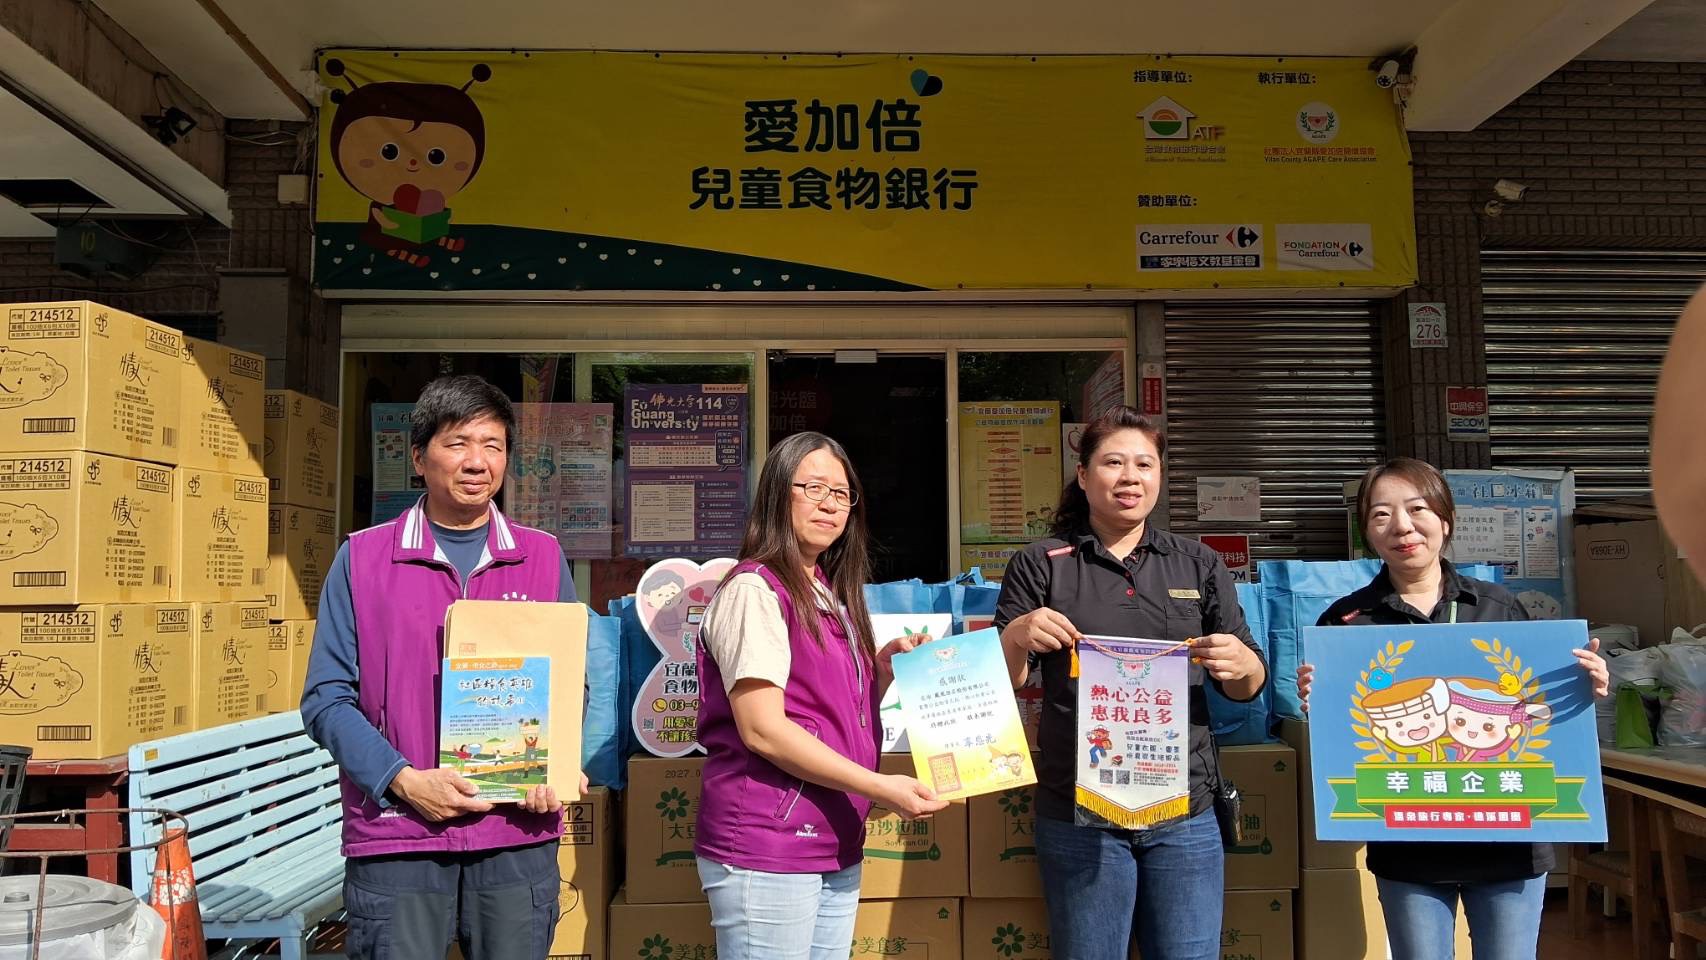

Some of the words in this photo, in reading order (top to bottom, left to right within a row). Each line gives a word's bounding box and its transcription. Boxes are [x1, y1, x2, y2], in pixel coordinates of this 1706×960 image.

[1133, 70, 1193, 83] 指導單位:
[1257, 72, 1317, 84] 執行單位:
[744, 98, 923, 153] 愛加倍
[688, 166, 978, 211] 兒童食物銀行
[1139, 230, 1220, 245] Carrefour
[1283, 241, 1340, 250] FONDATION
[1298, 249, 1339, 258] Carrefour
[30, 309, 74, 322] 214512
[150, 329, 177, 347] 214512
[1416, 324, 1442, 339] 276
[233, 355, 260, 372] 214512
[696, 397, 723, 410] 114
[631, 409, 675, 421] Guang
[1450, 418, 1485, 428] SECOM
[20, 460, 65, 473] 214512
[140, 469, 166, 483] 214512
[238, 481, 263, 494] 214512
[43, 613, 89, 625] 214512
[161, 611, 185, 623] 214512
[244, 609, 265, 620] 214512
[663, 679, 698, 694] 食物
[1090, 684, 1173, 707] 熱心公益
[1090, 704, 1174, 725] 惠我良多
[1386, 770, 1524, 794] 幸福企業
[858, 936, 909, 955] 美食家
